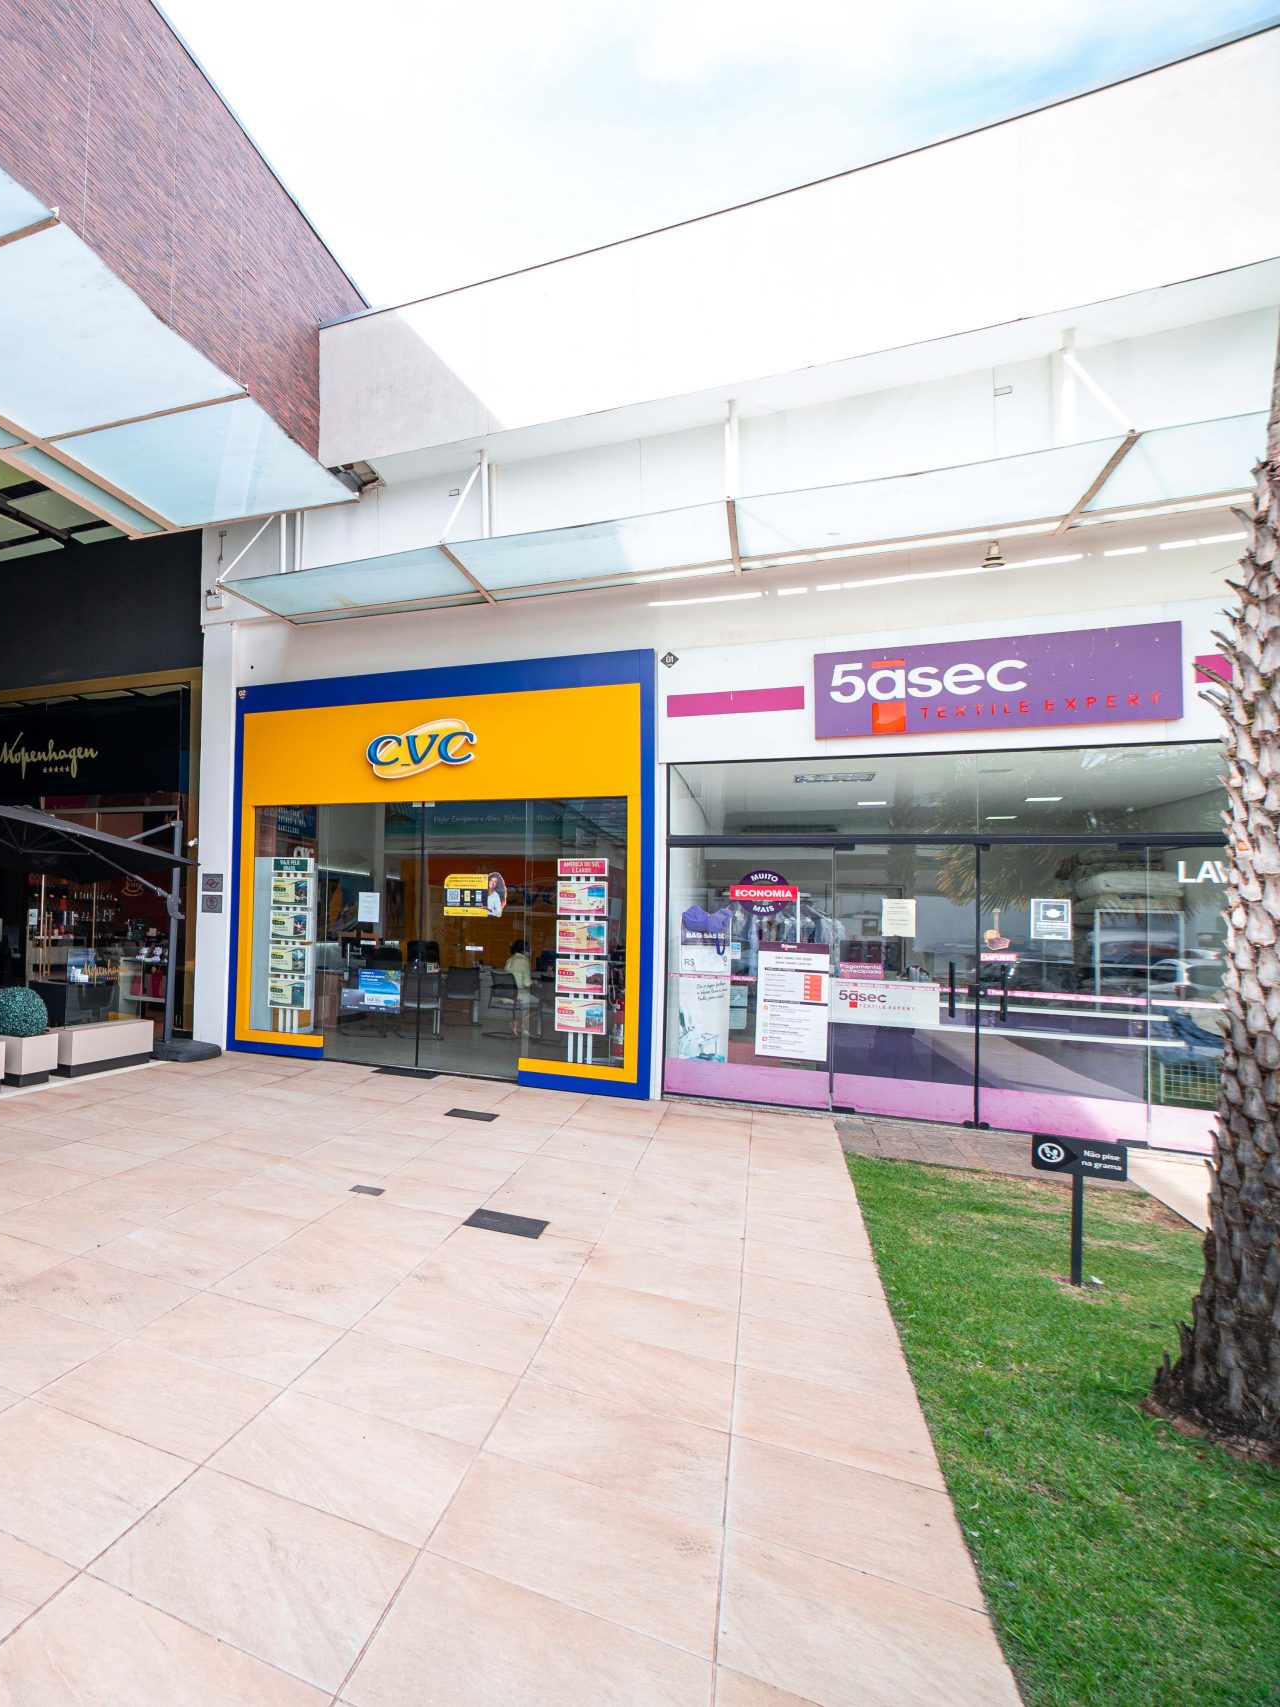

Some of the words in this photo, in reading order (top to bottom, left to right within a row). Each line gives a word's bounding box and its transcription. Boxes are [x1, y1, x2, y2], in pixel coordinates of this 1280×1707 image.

[920, 700, 1030, 719] TEXTILE
[1044, 691, 1164, 713] EXPERT
[366, 729, 477, 767] CVC
[0, 731, 99, 779] Kopenhagen
[750, 873, 779, 883] MUITO
[735, 889, 793, 898] ECONOMIA
[753, 904, 775, 913] MAIS
[981, 953, 1016, 961] EMPURRE
[1083, 1149, 1101, 1159] Não
[1101, 1153, 1120, 1162] pise
[1093, 1162, 1122, 1171] grama
